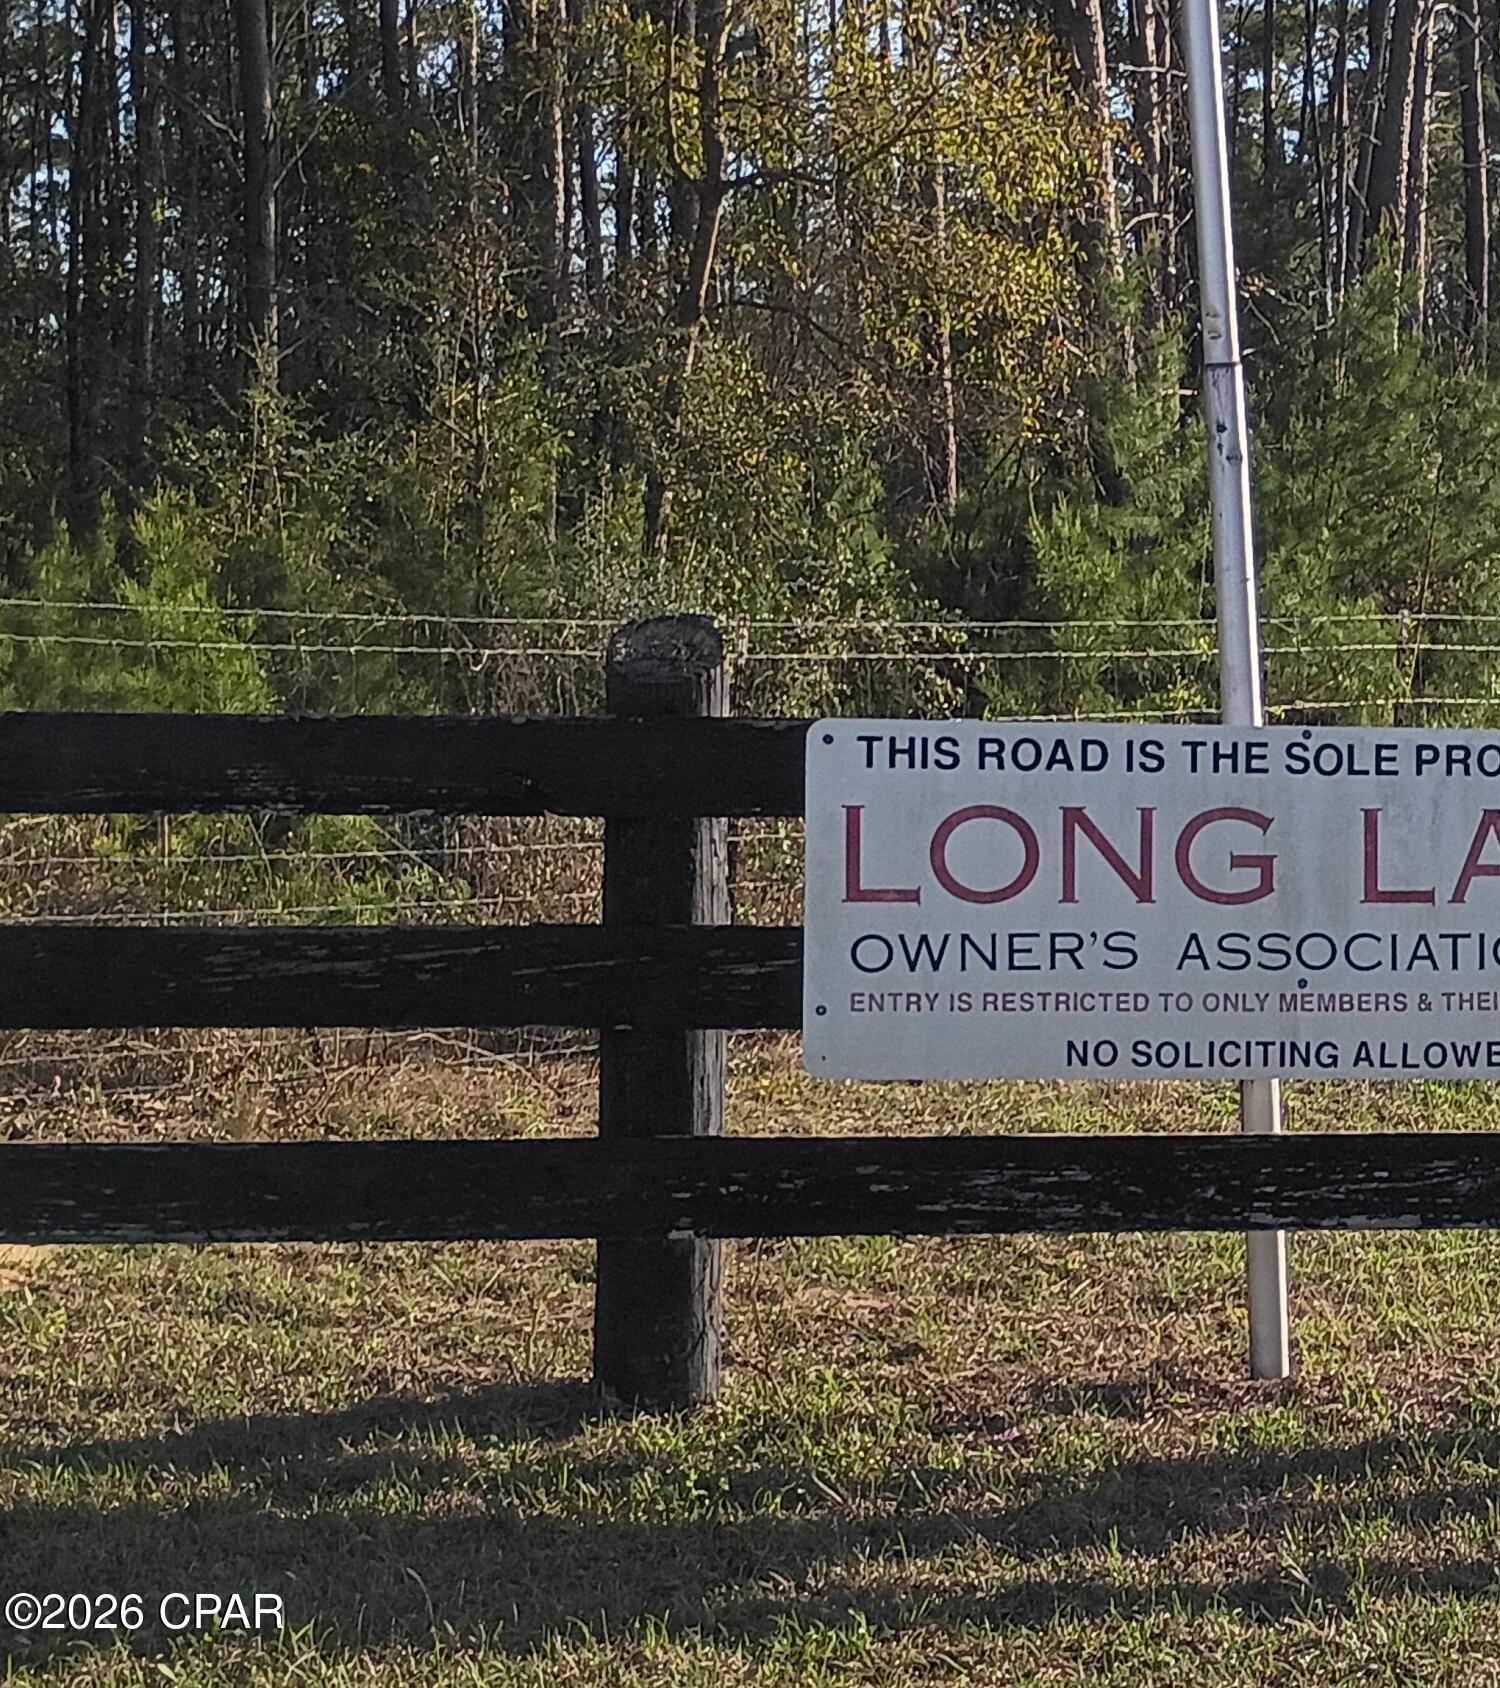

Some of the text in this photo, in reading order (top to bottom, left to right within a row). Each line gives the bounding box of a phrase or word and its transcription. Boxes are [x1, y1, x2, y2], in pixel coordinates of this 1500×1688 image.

[857, 735, 960, 770] THIS
[978, 737, 1108, 772] ROAD
[1126, 739, 1165, 774] IS
[1181, 741, 1269, 774] THE
[1284, 742, 1399, 776] SOLE
[841, 804, 1278, 906] LONG
[850, 992, 939, 1013] ENTRY
[949, 993, 973, 1012] IS
[982, 992, 1150, 1013] RESTRICTED
[1159, 992, 1193, 1013] TO
[1202, 992, 1269, 1013] ONLY
[1279, 992, 1408, 1013] MEMBERS
[1419, 992, 1433, 1012] &
[1066, 1040, 1118, 1068] NO
[1131, 1040, 1339, 1069] SOLICITING
